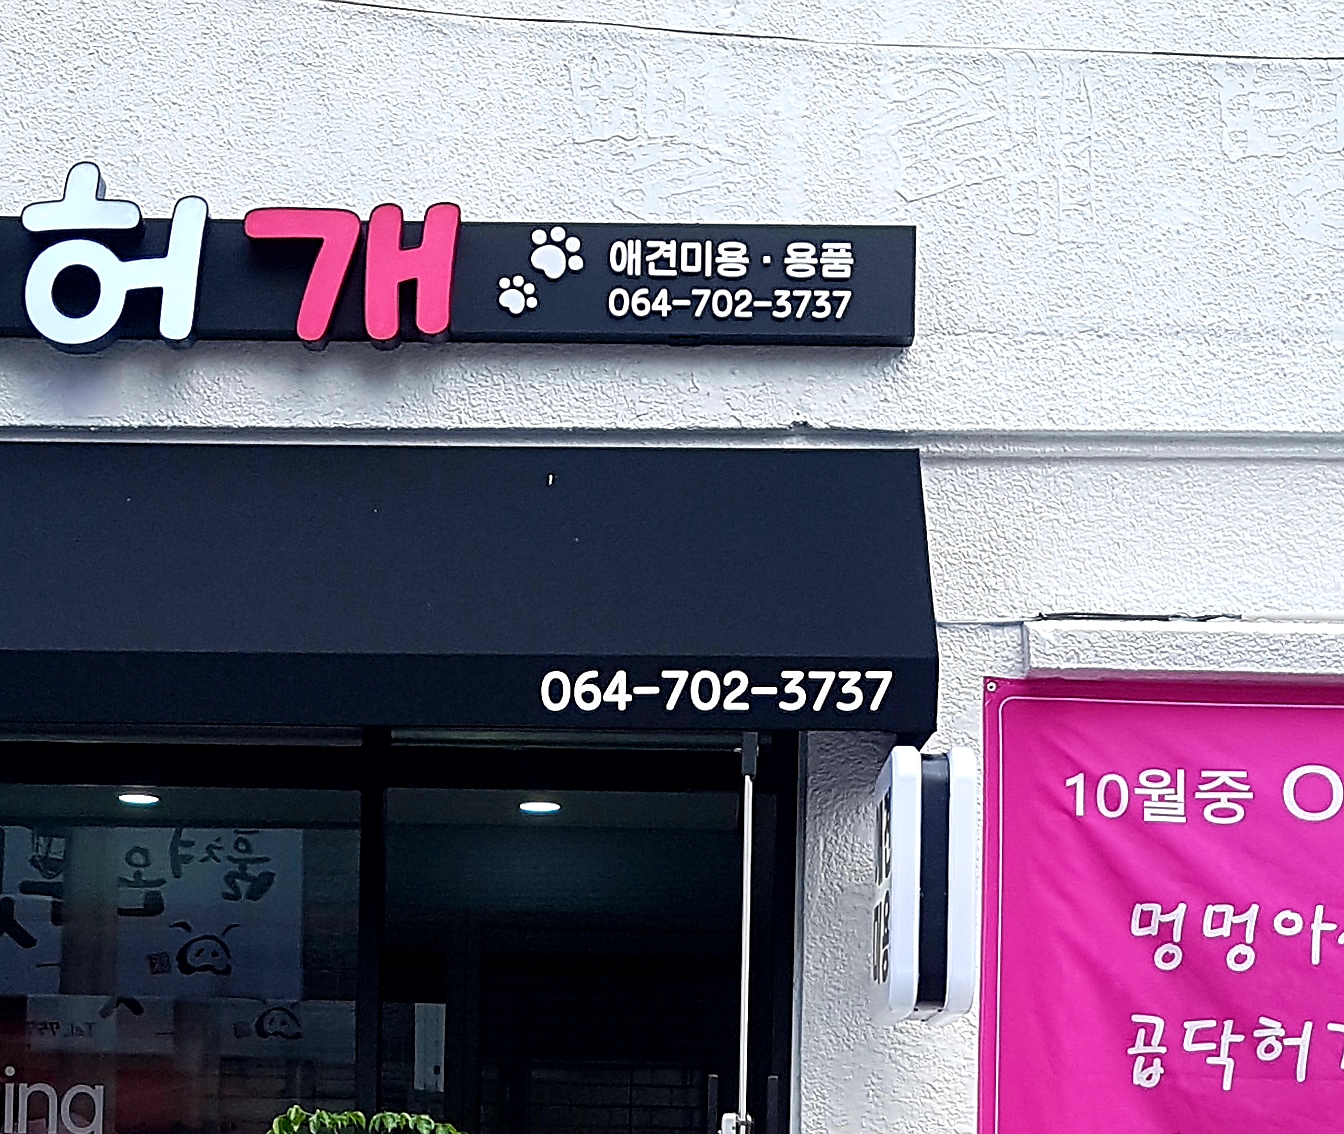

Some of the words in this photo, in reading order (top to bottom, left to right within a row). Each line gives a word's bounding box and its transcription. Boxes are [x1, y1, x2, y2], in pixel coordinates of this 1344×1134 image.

[609, 239, 750, 278] 애견미용
[783, 241, 854, 279] 용품
[608, 287, 852, 319] 064-702-3737
[540, 670, 893, 712] 064-702-3737
[1064, 767, 1254, 825] 10월중
